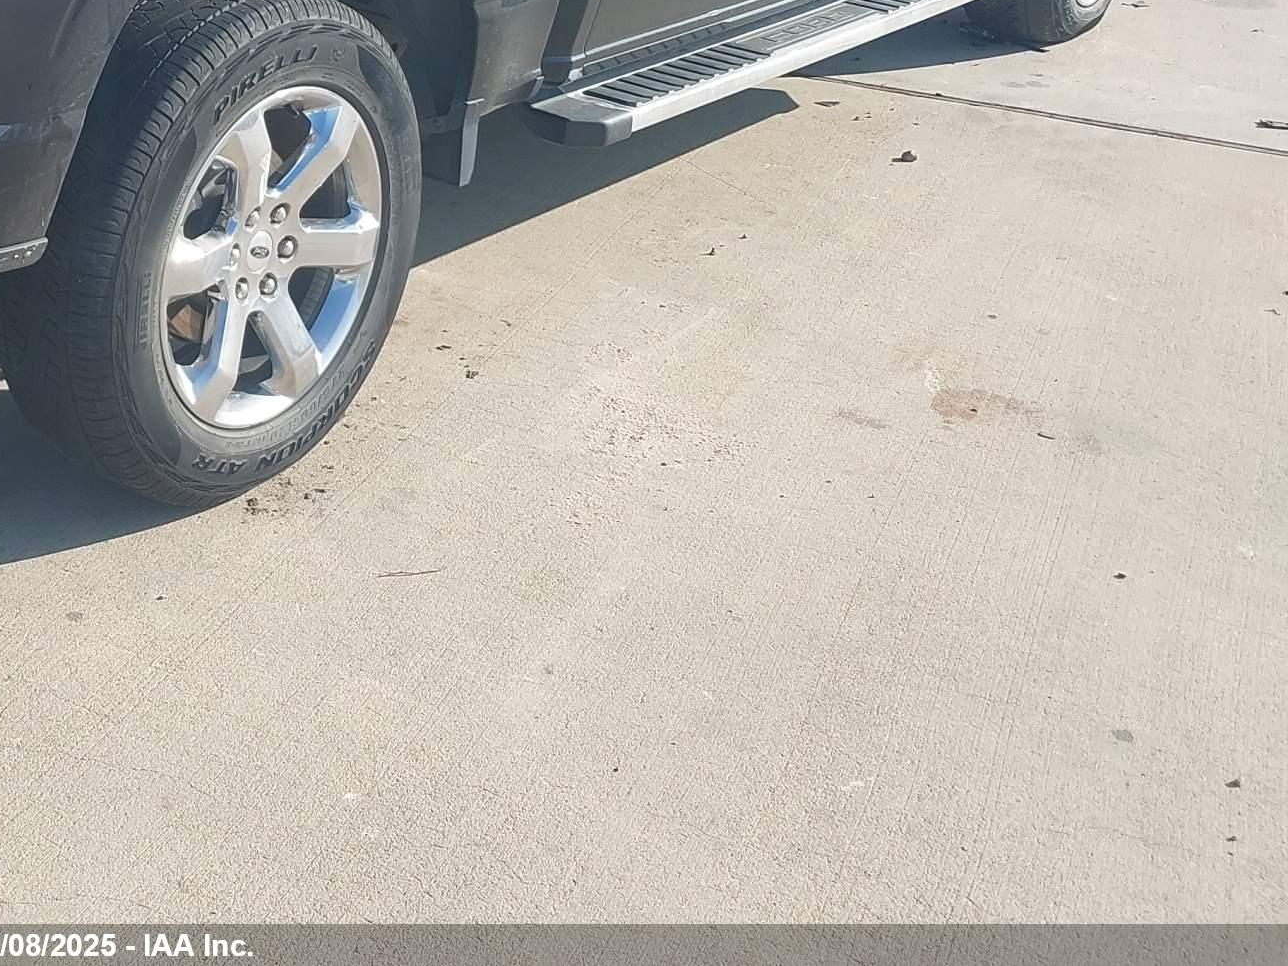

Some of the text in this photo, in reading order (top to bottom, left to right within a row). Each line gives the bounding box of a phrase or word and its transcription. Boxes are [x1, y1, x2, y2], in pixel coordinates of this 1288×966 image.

[213, 43, 319, 126] PIRELLI
[253, 338, 377, 472] SCORPION
[191, 450, 248, 476] ATR
